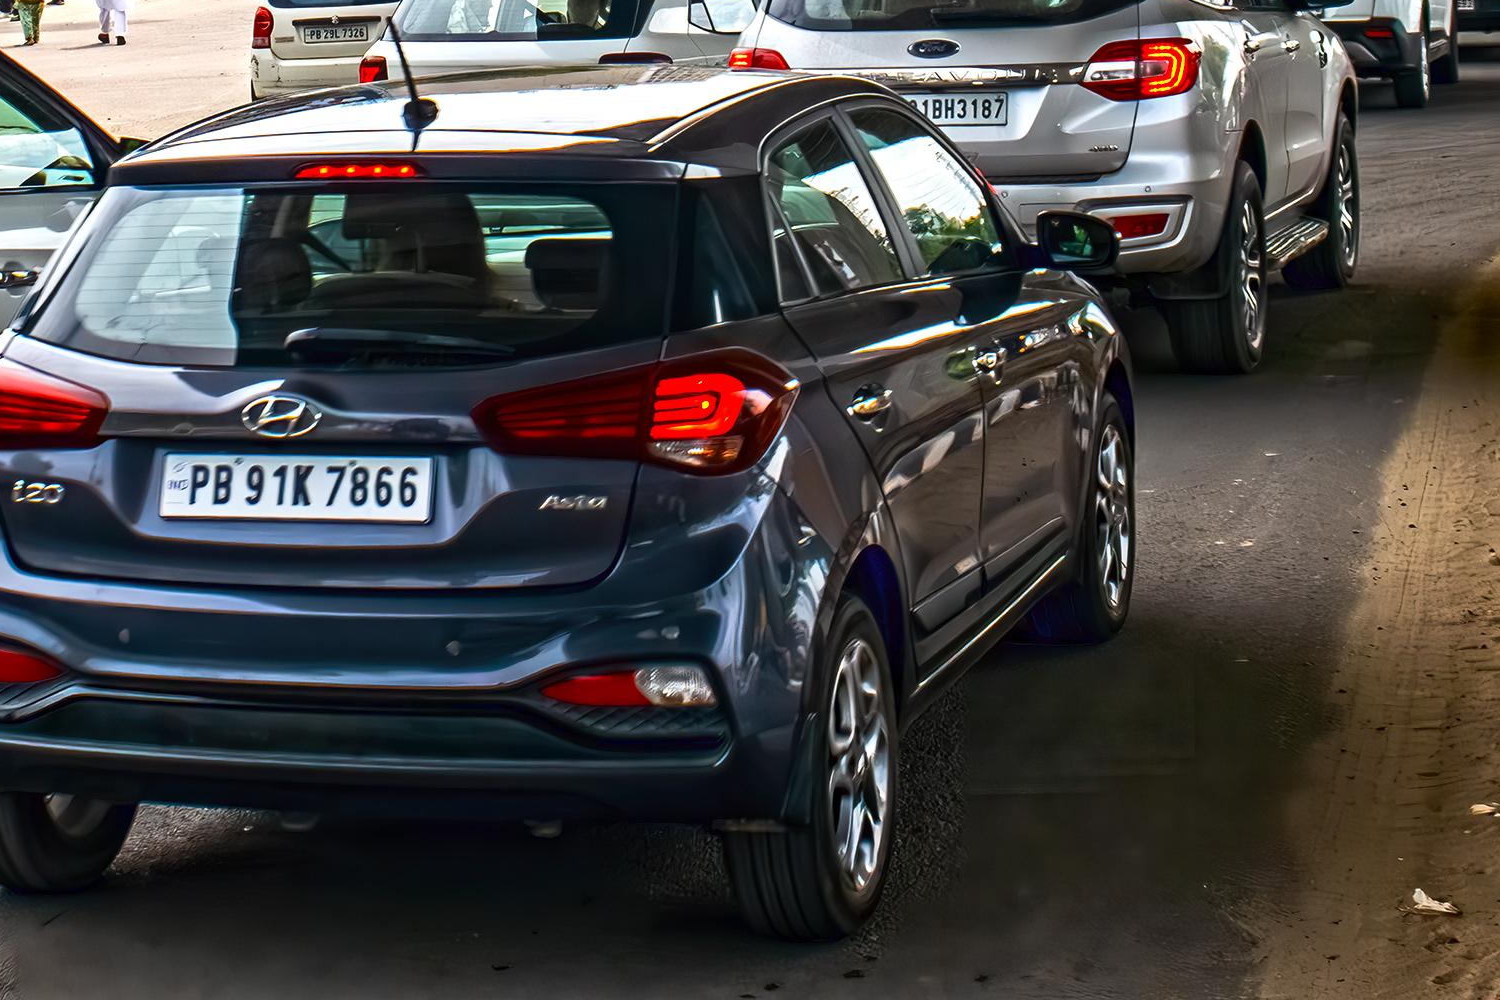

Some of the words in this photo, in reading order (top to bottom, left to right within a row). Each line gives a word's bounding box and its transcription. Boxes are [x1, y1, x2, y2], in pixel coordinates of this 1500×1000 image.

[309, 29, 322, 40] PB
[323, 29, 340, 39] 29L
[342, 28, 365, 38] 7326
[922, 43, 948, 53] Ford
[11, 479, 65, 503] i20
[188, 464, 232, 505] PB
[244, 464, 312, 507] 91K
[325, 465, 419, 508] 7866
